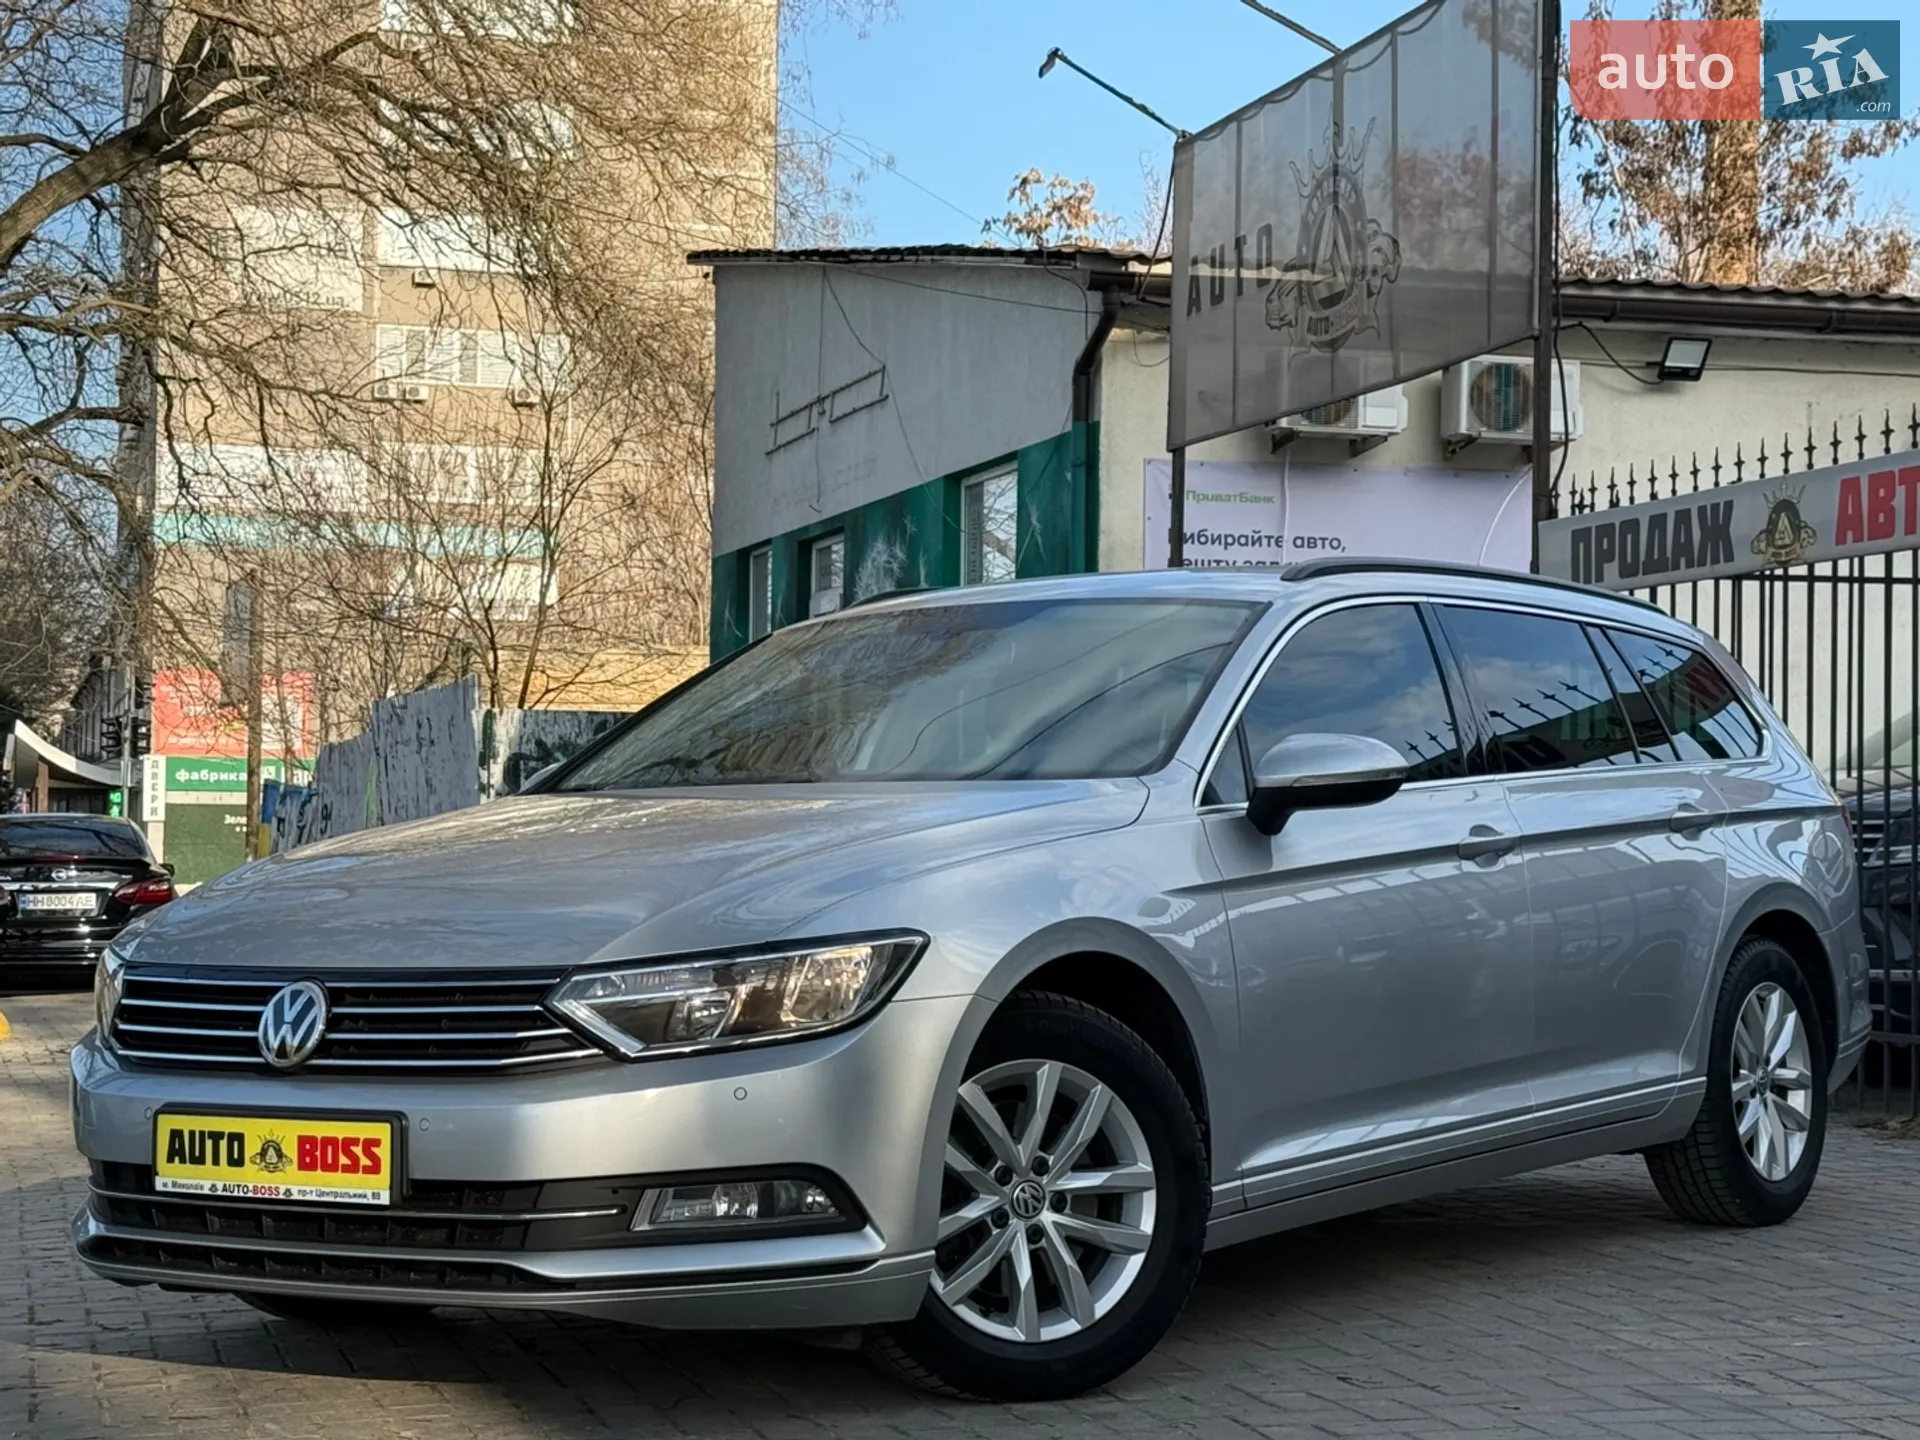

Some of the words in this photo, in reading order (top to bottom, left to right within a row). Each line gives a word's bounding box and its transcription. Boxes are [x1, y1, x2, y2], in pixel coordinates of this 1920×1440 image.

[1186, 223, 1273, 317] AUTO
[1186, 490, 1276, 504] ПриватБанк
[1168, 528, 1284, 550] ибирайте
[1292, 535, 1346, 552] авто,
[1571, 500, 1735, 585] ПРОДАЖ
[175, 768, 248, 783] фабрика
[166, 1128, 245, 1168] AUTO
[297, 1135, 382, 1175] BOSS
[221, 1183, 280, 1197] AUTO-BOSS
